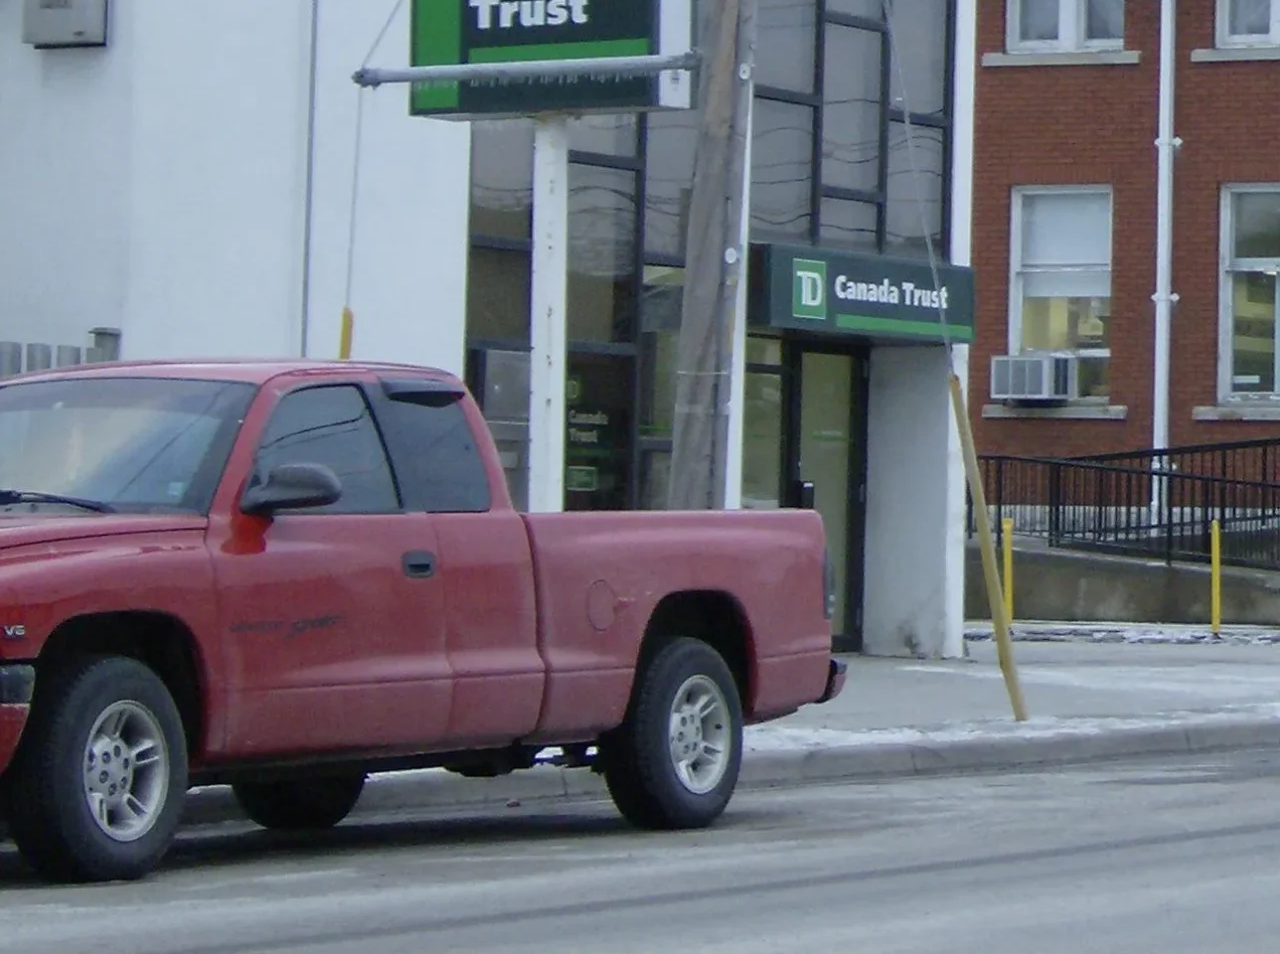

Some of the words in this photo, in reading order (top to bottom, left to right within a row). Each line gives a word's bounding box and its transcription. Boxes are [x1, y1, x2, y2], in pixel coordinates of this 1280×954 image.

[796, 270, 823, 307] TD
[834, 274, 900, 305] Canada
[902, 281, 949, 310] Trust
[4, 624, 25, 636] V6
